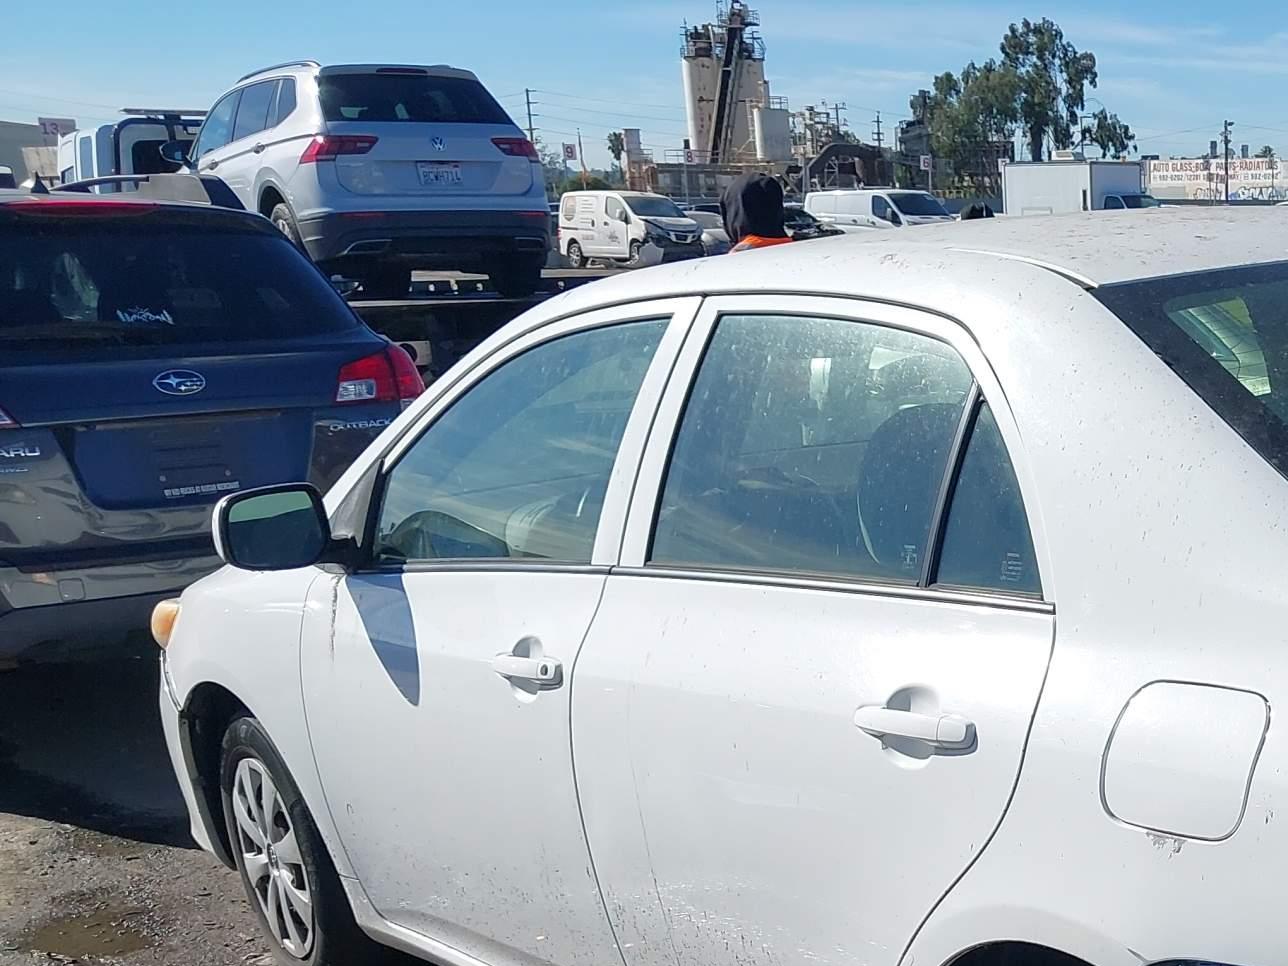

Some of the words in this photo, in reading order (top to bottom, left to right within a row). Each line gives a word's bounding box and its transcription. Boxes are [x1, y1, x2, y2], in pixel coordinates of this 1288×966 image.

[41, 122, 59, 135] 13
[565, 145, 574, 158] 9
[686, 151, 694, 162] 8
[922, 157, 930, 168] 6
[1152, 162, 1170, 172] AUTO
